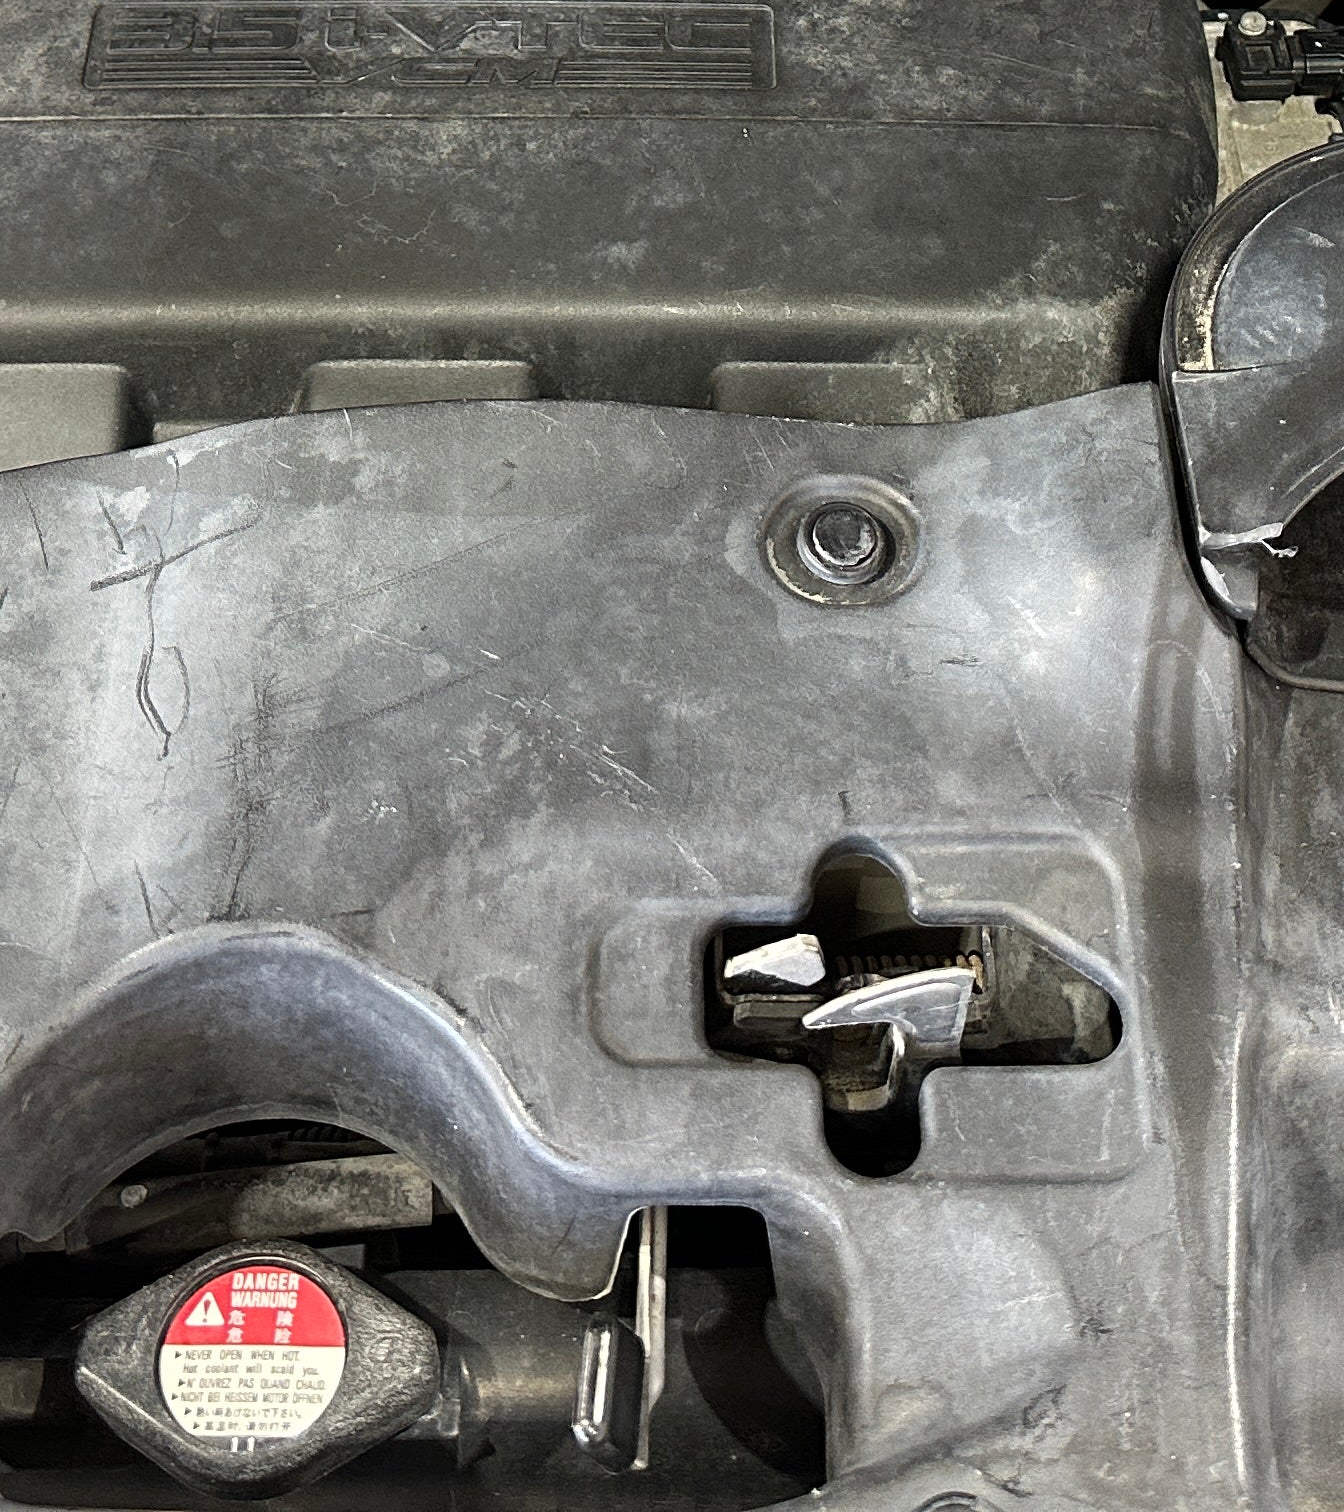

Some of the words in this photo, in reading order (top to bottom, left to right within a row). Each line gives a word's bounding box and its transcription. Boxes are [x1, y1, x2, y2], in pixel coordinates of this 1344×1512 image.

[232, 1272, 300, 1290] DANGER
[231, 1291, 298, 1309] WARNUNG
[185, 1349, 212, 1360] NEVER
[219, 1349, 243, 1360] OPEN
[251, 1350, 275, 1361] WHEN
[246, 1363, 263, 1374] will
[238, 1377, 255, 1389] PAS
